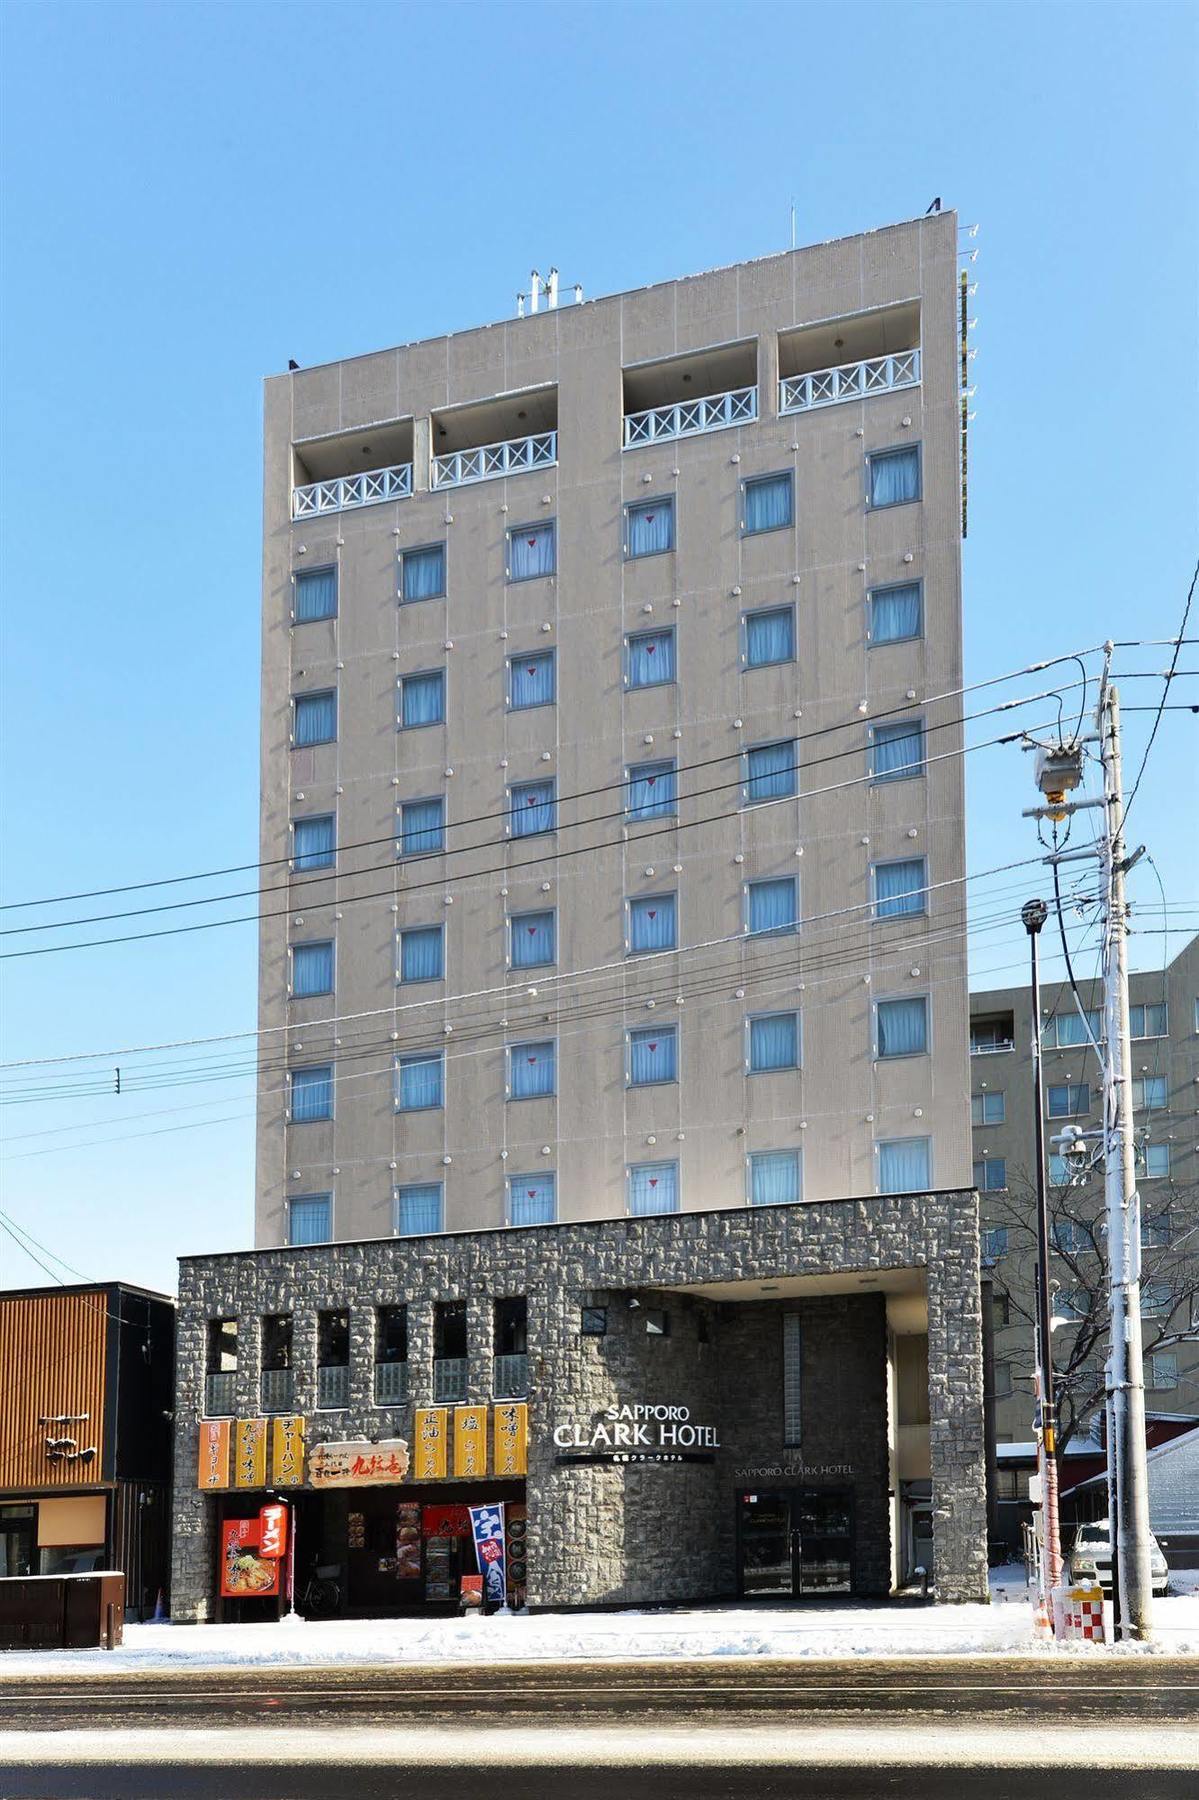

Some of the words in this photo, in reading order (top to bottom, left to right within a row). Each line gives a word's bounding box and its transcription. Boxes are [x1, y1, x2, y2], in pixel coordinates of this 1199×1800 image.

[607, 1404, 690, 1421] SAPPORO
[282, 1419, 294, 1474] チャーハン
[553, 1422, 651, 1448] CLARK
[660, 1424, 721, 1448] HOTEL
[735, 1466, 781, 1478] SAPPORO
[784, 1465, 817, 1476] CLARK
[820, 1464, 854, 1474] HOTEL
[261, 1507, 282, 1553] ラーメン
